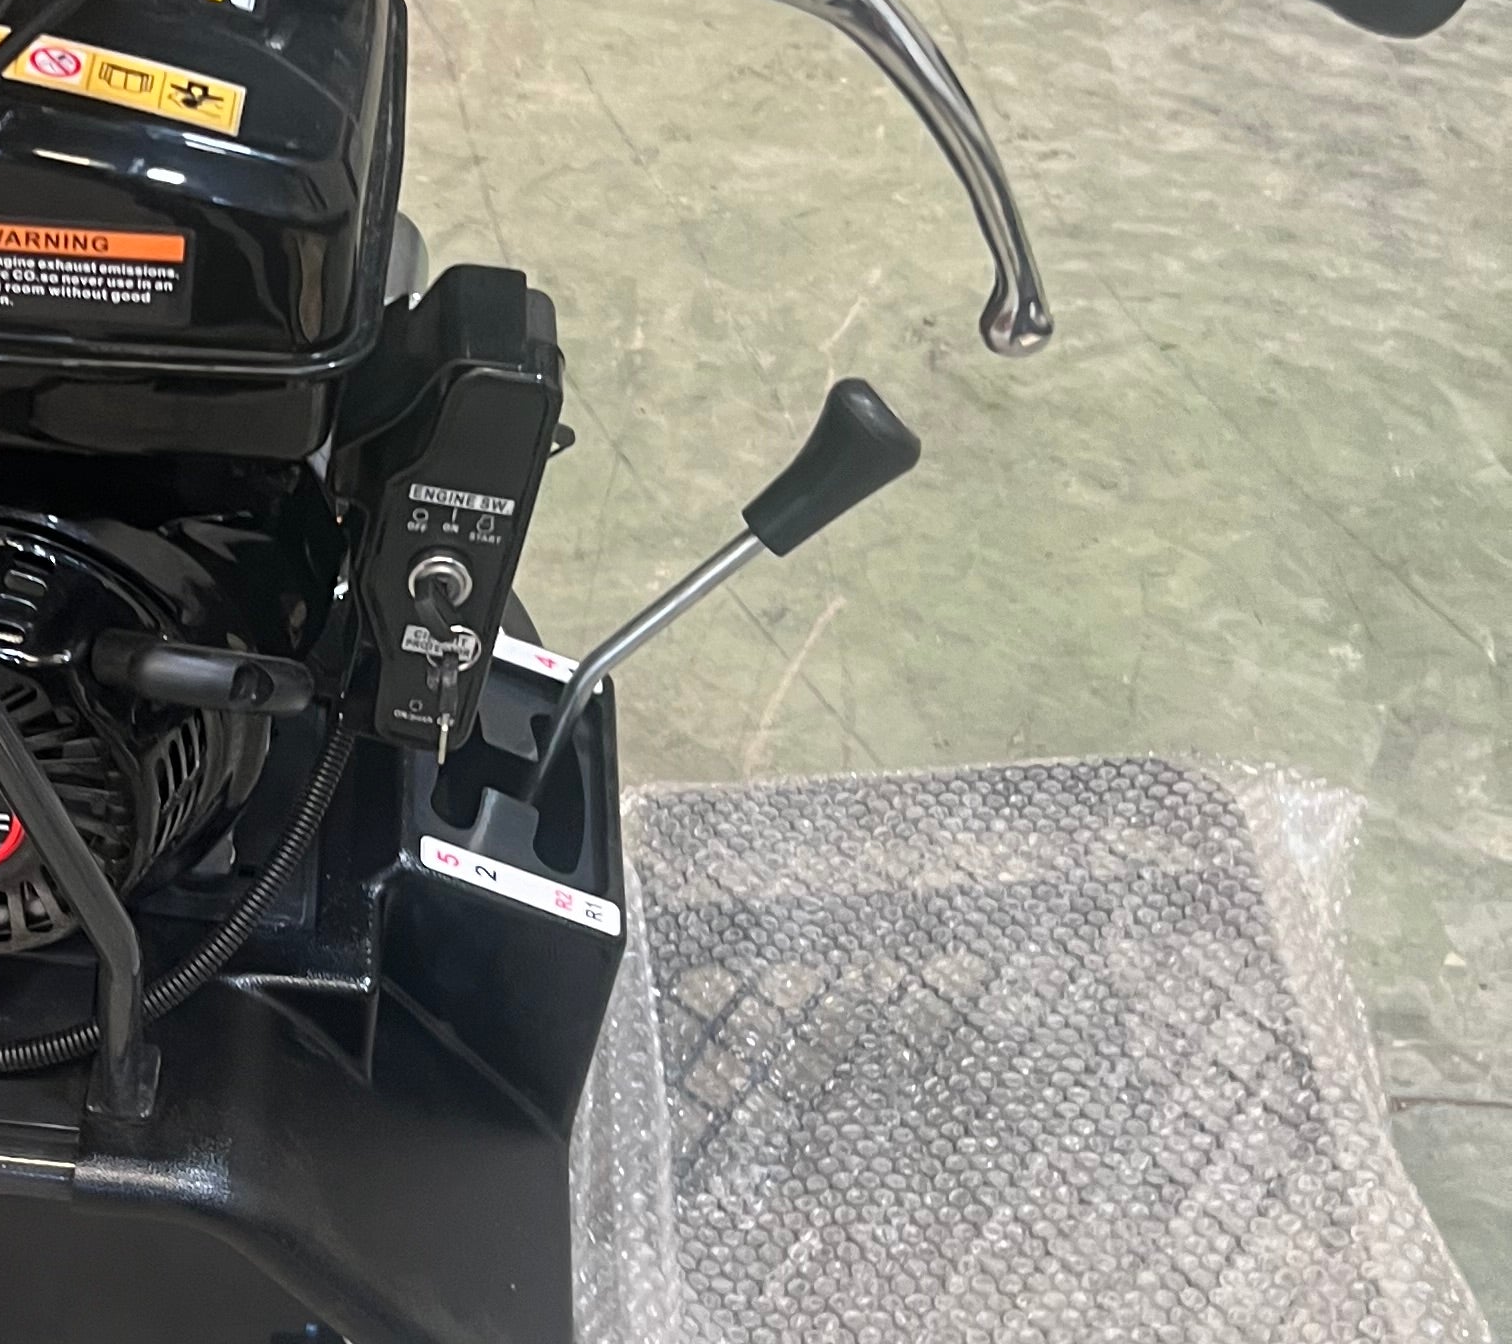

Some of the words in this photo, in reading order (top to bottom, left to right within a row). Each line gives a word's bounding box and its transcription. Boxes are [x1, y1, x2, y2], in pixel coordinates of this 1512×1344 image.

[38, 258, 97, 274] exhaust
[61, 274, 104, 288] never
[106, 278, 134, 290] use
[136, 277, 151, 291] in
[155, 280, 173, 292] an
[4, 283, 45, 296] room
[48, 285, 108, 302] without
[111, 290, 151, 305] good
[413, 483, 477, 509] ENGINE
[442, 522, 460, 534] ON
[469, 531, 502, 545] START
[534, 654, 557, 670] 4
[437, 850, 460, 867] 5
[475, 864, 497, 882] 2
[554, 889, 573, 912] R2
[585, 901, 603, 922] R1
